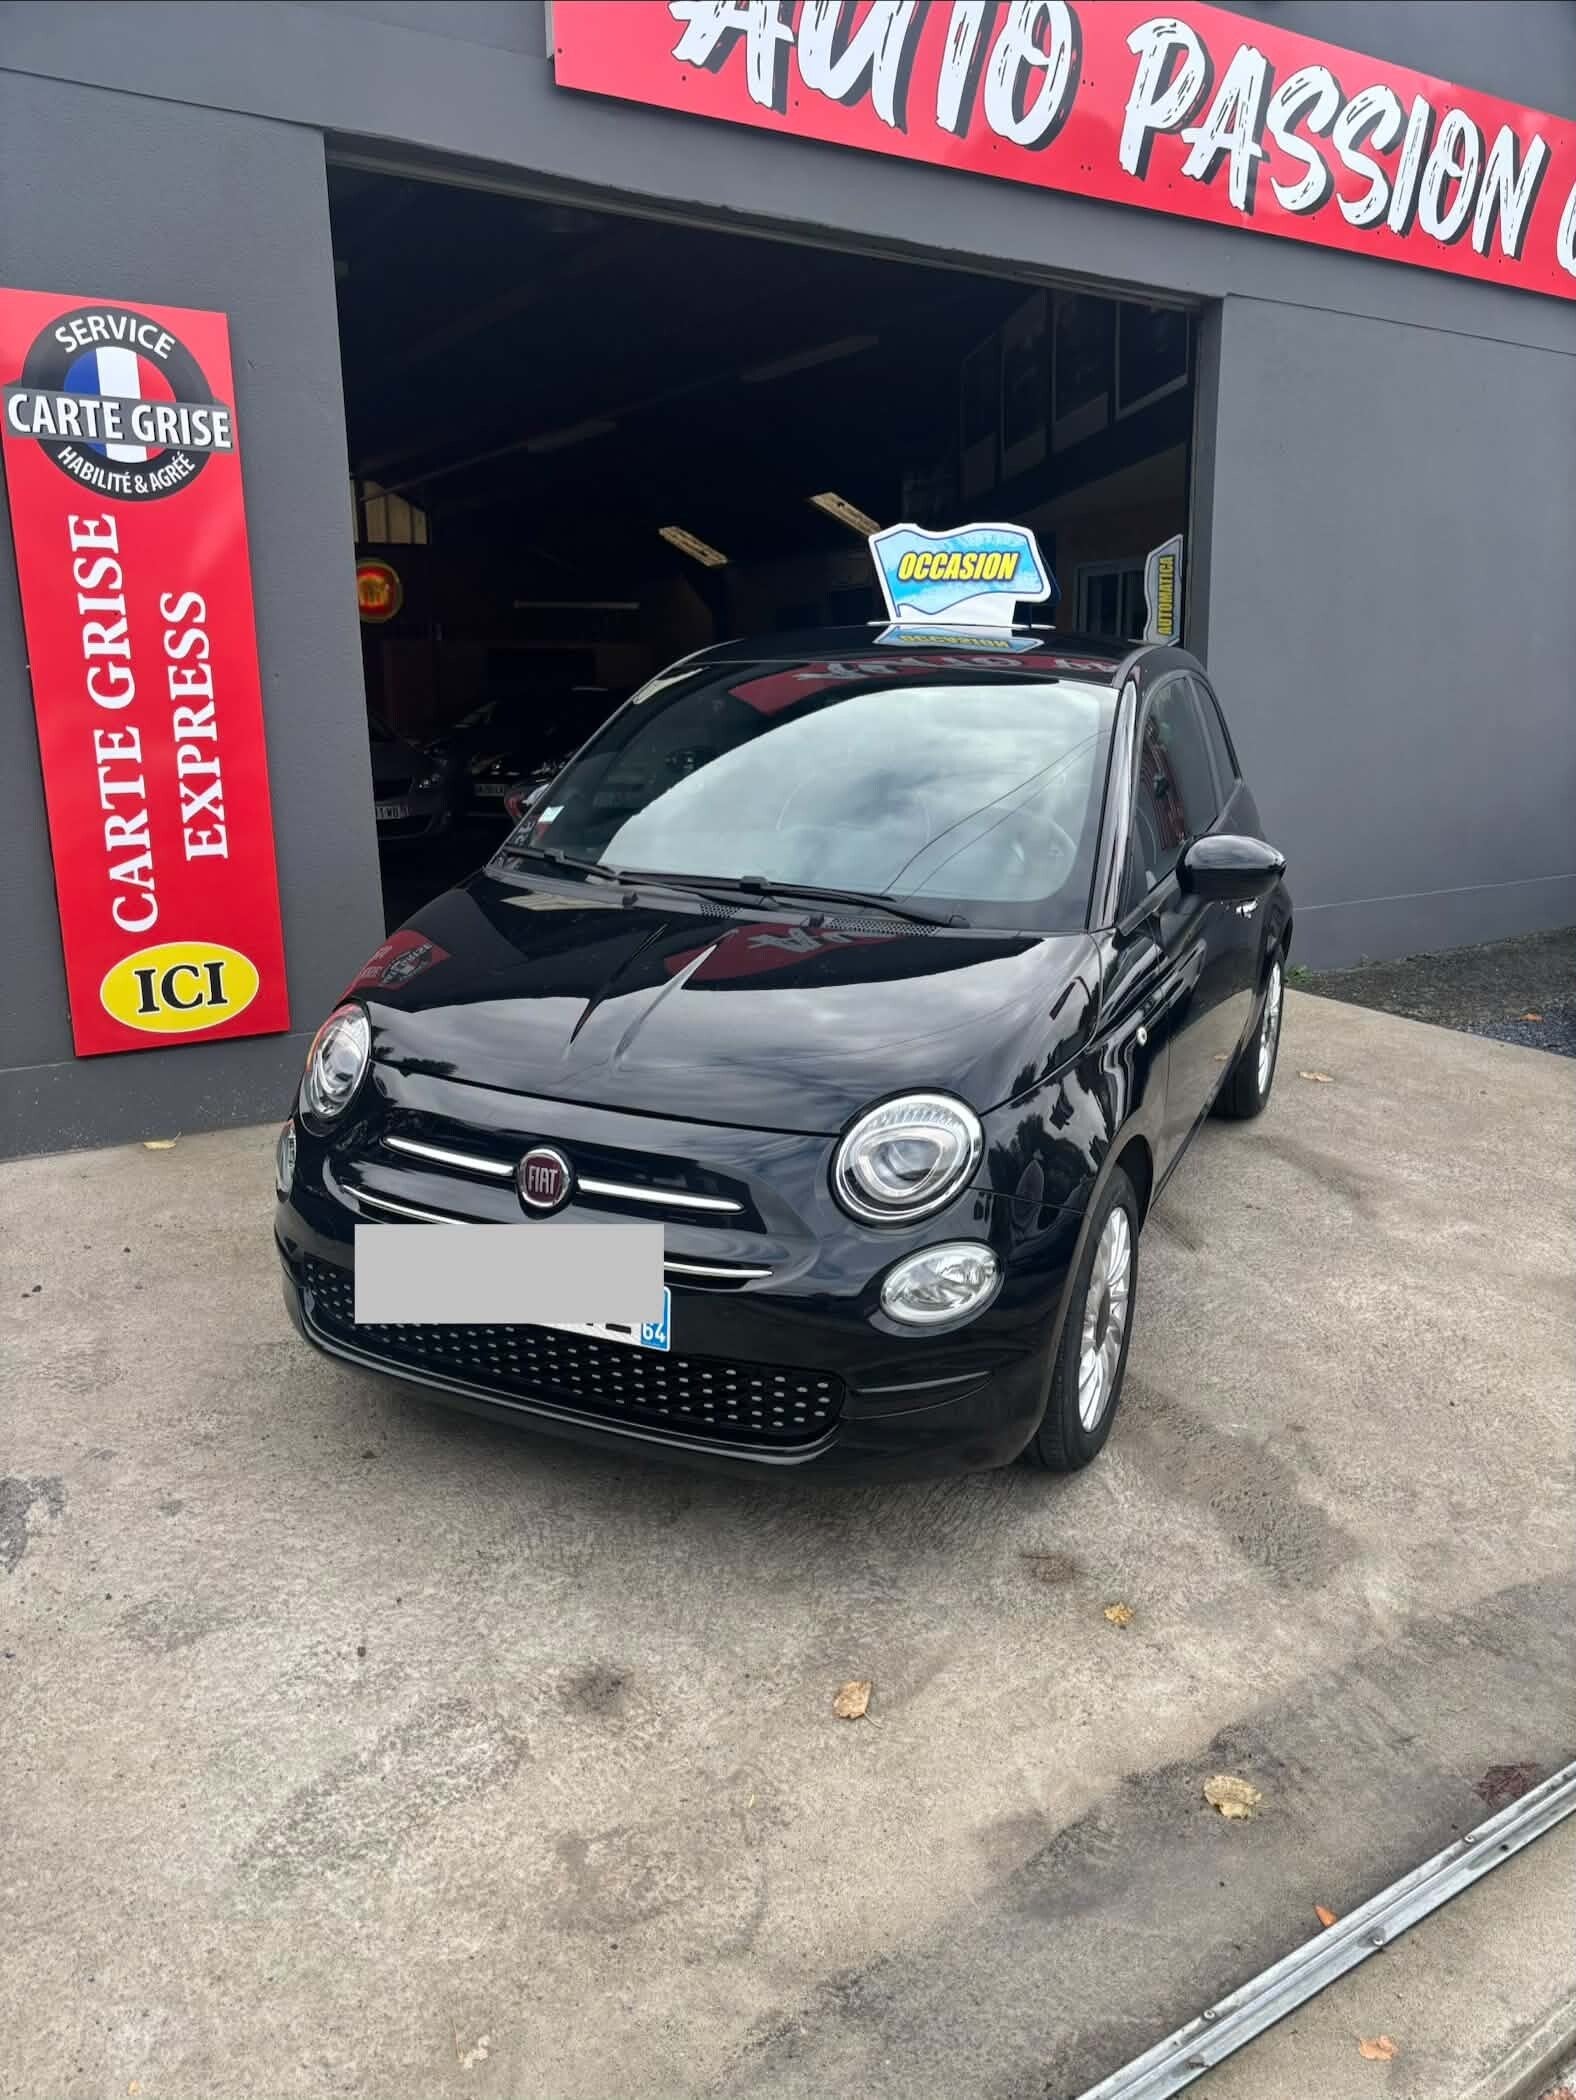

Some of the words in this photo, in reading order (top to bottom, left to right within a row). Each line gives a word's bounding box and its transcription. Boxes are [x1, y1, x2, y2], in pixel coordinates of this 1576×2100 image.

[1119, 17, 1550, 260] PASSION
[55, 314, 175, 359] SERVICE
[8, 394, 123, 440] CARTE
[131, 404, 232, 449] GRISE
[57, 446, 133, 494] HABILITÉ
[135, 477, 149, 494] &
[150, 451, 195, 492] AGRÉÉ
[897, 551, 1021, 582] OCCASION
[68, 512, 136, 711] GRISE
[160, 590, 229, 861] EXPRESS
[94, 726, 159, 934] CARTE
[134, 961, 229, 1014] ICI
[528, 1165, 559, 1195] FIAT
[642, 1322, 665, 1343] 64
